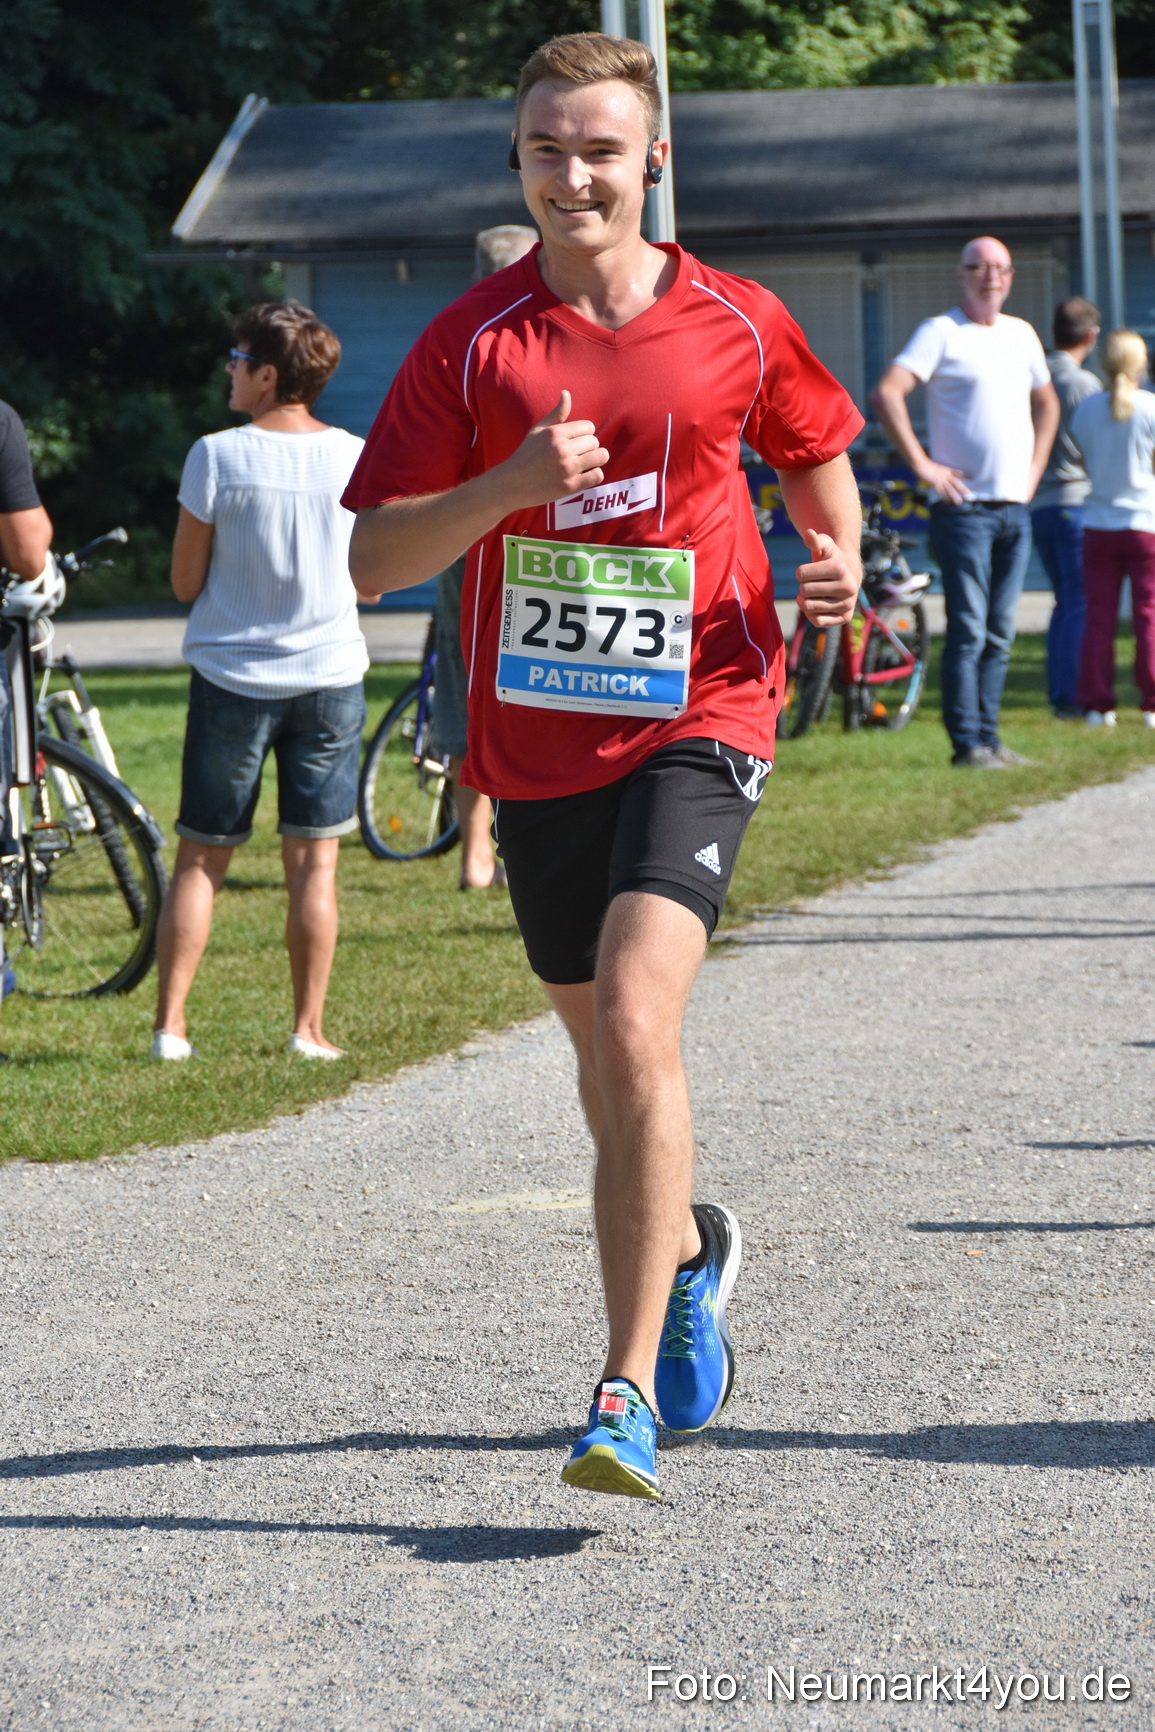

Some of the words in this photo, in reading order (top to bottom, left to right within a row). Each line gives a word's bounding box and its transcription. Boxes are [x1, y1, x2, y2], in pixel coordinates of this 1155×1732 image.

[582, 490, 629, 515] DEHN
[518, 544, 676, 594] BOCK
[521, 597, 666, 658] 2573
[674, 614, 683, 624] C
[528, 665, 651, 697] PATRICK
[694, 852, 721, 875] adidas
